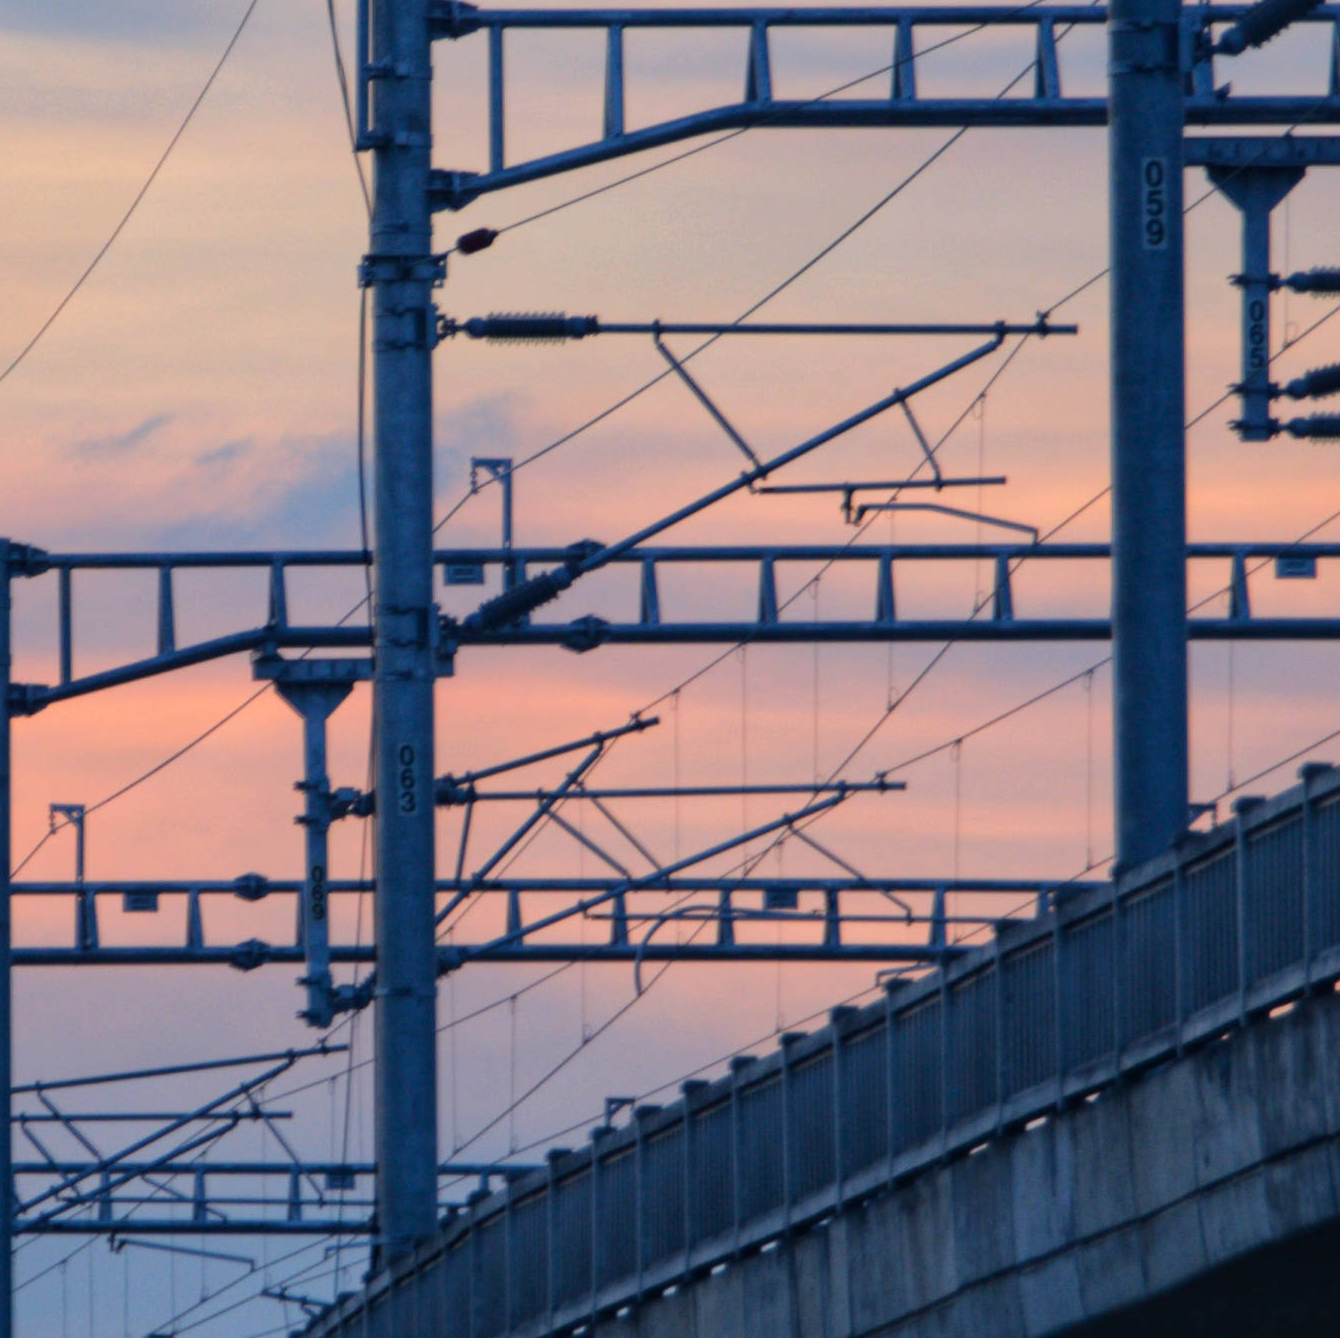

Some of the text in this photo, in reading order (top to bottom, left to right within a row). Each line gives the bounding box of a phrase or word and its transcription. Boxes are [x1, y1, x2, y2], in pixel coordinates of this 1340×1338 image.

[1145, 160, 1164, 245] 059
[1249, 300, 1265, 369] 065
[399, 744, 416, 813] 063
[312, 865, 325, 921] 069
